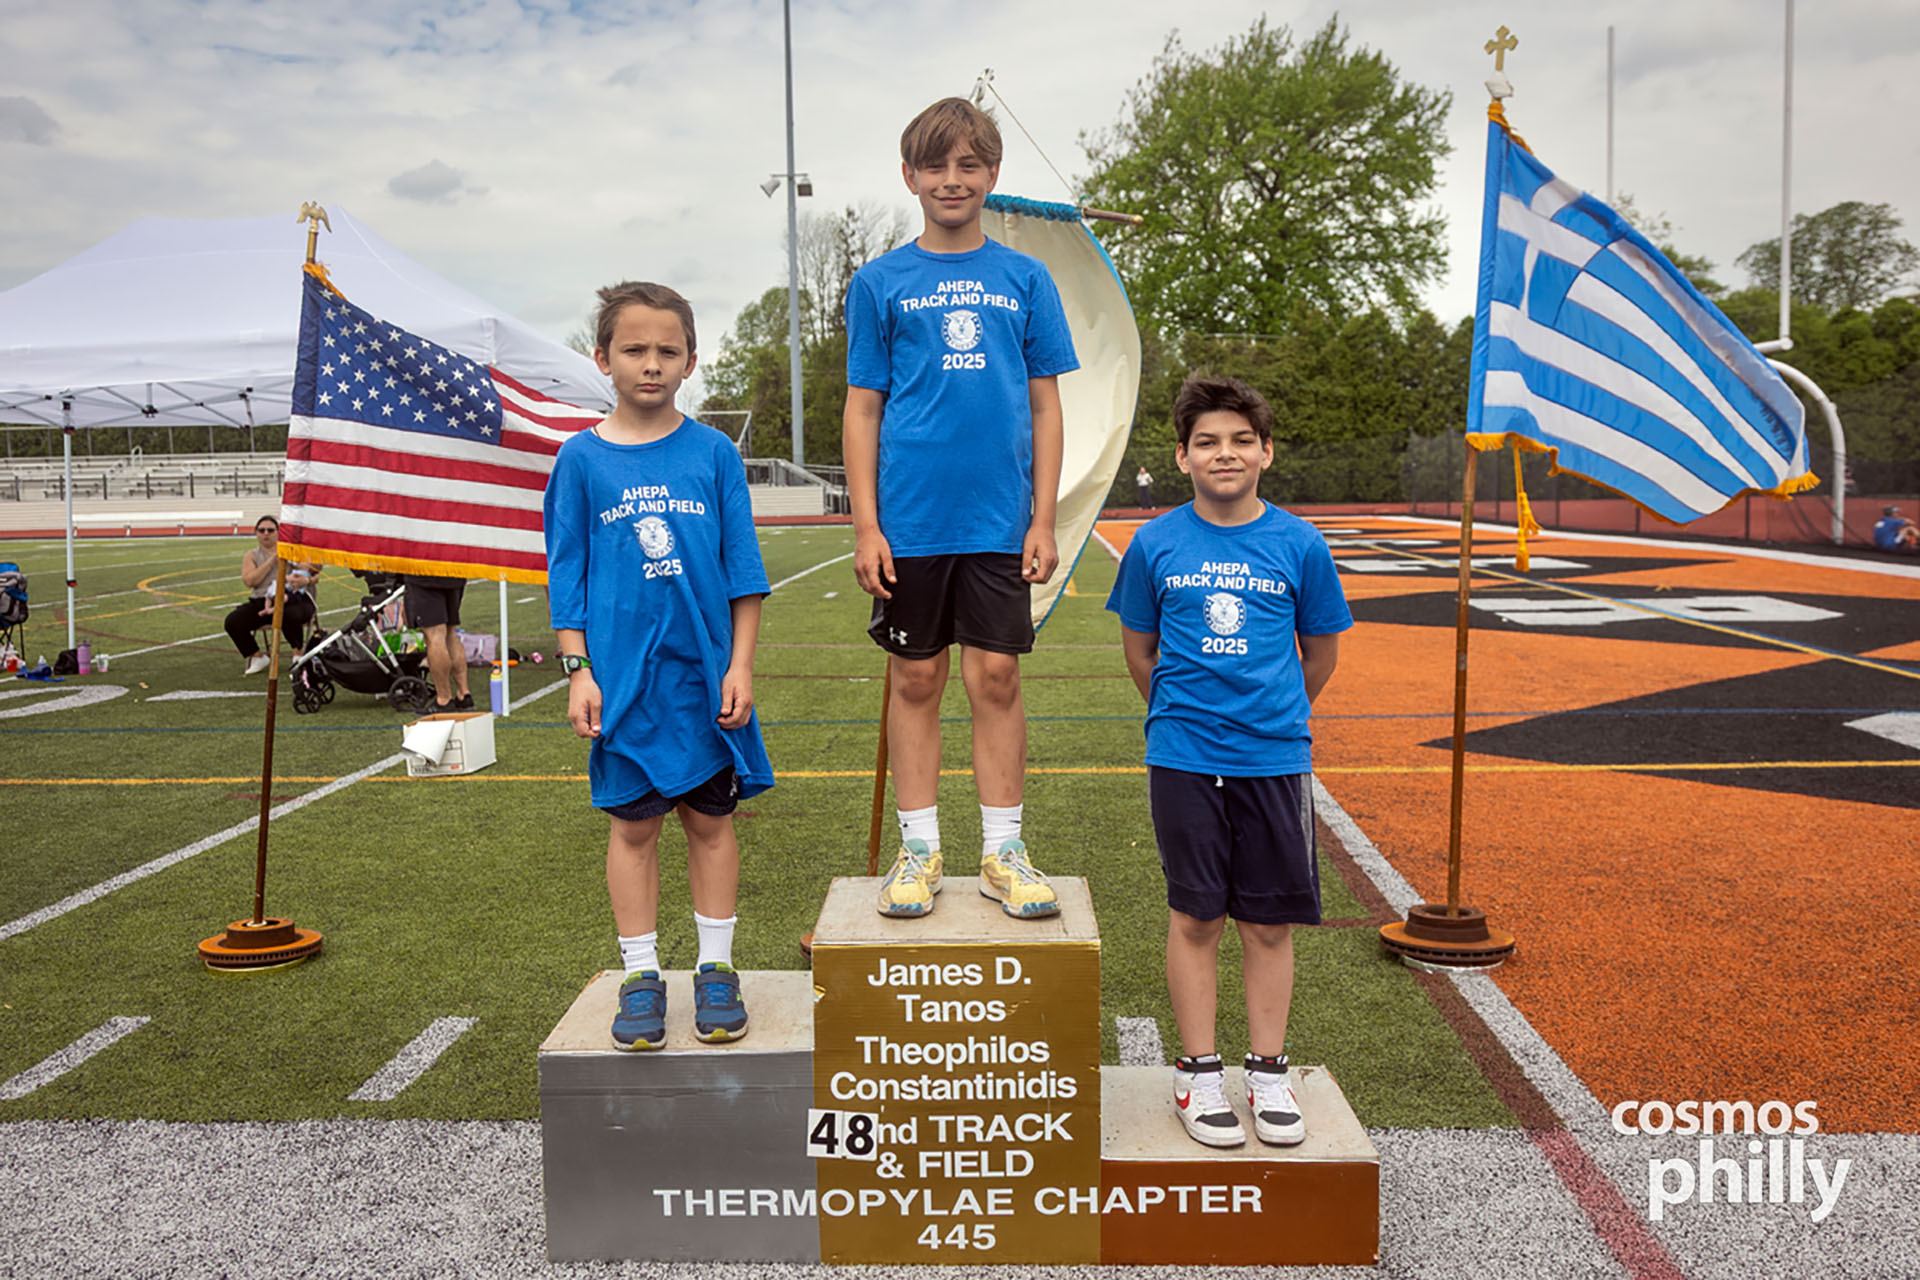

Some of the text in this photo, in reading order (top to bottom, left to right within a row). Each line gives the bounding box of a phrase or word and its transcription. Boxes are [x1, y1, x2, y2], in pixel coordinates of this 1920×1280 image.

[936, 280, 985, 294] AHEPA
[900, 292, 1019, 312] TRACK AND FIELD
[941, 353, 986, 370] 2025
[622, 484, 670, 501] AHEPA
[600, 499, 706, 526] TRACK AND FIELD
[642, 559, 684, 580] 2025
[1200, 561, 1251, 576] AHEPA
[1165, 574, 1287, 595] TRACK AND FIELD
[1201, 636, 1249, 655] 2025
[867, 956, 1032, 987] James D.
[896, 993, 1007, 1023] Tanos
[855, 1035, 1051, 1073] Theophilos
[829, 1070, 1078, 1101] Constantinidis
[928, 1112, 1074, 1144] TRACK
[875, 1149, 1035, 1180] & FIELD
[652, 1184, 1264, 1217] THERMOPYLAE CHAPTER
[917, 1223, 997, 1251] 445
